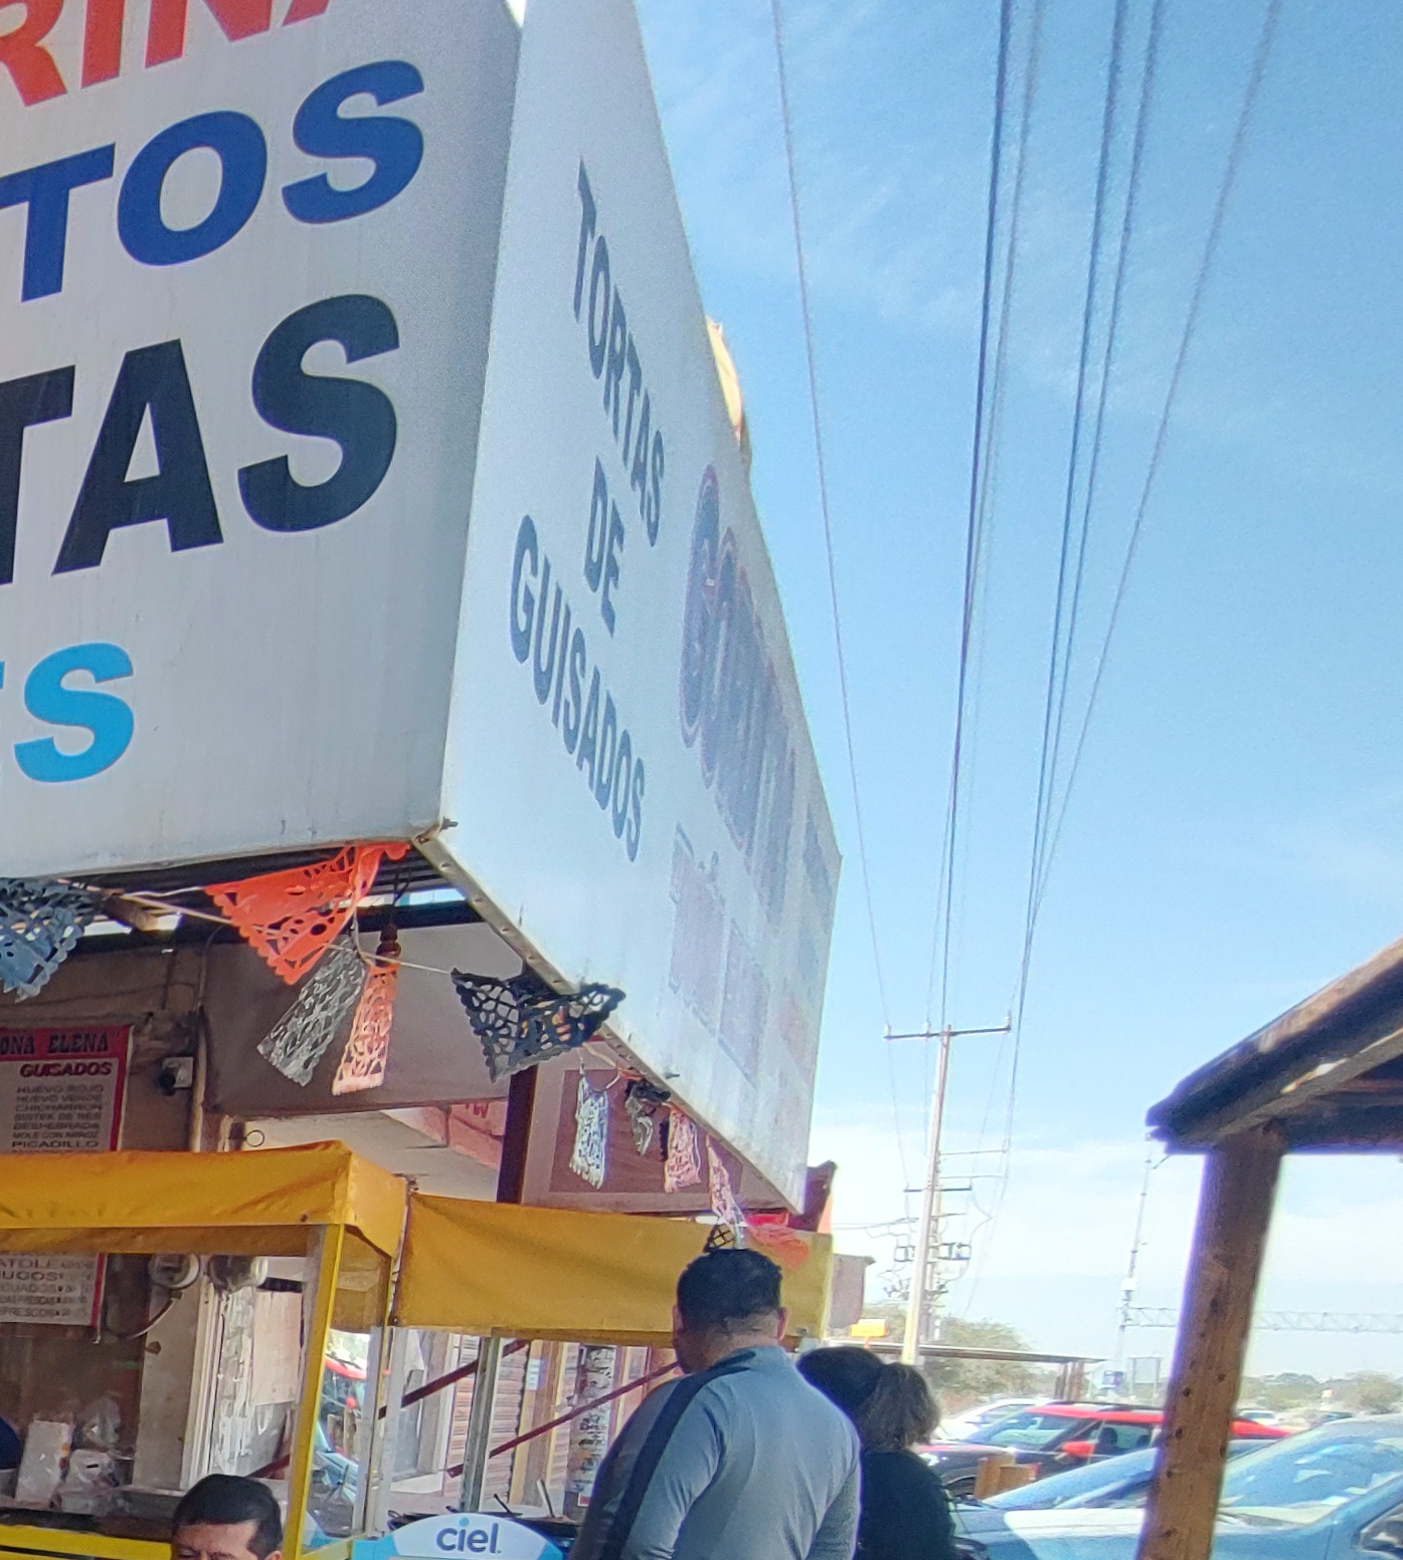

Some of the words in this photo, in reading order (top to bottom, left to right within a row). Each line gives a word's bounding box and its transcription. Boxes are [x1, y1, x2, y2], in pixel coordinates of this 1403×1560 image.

[573, 155, 665, 547] TORTAS
[584, 455, 624, 638] DE
[510, 514, 645, 862] GUISADOS
[436, 1517, 499, 1554] ciel
